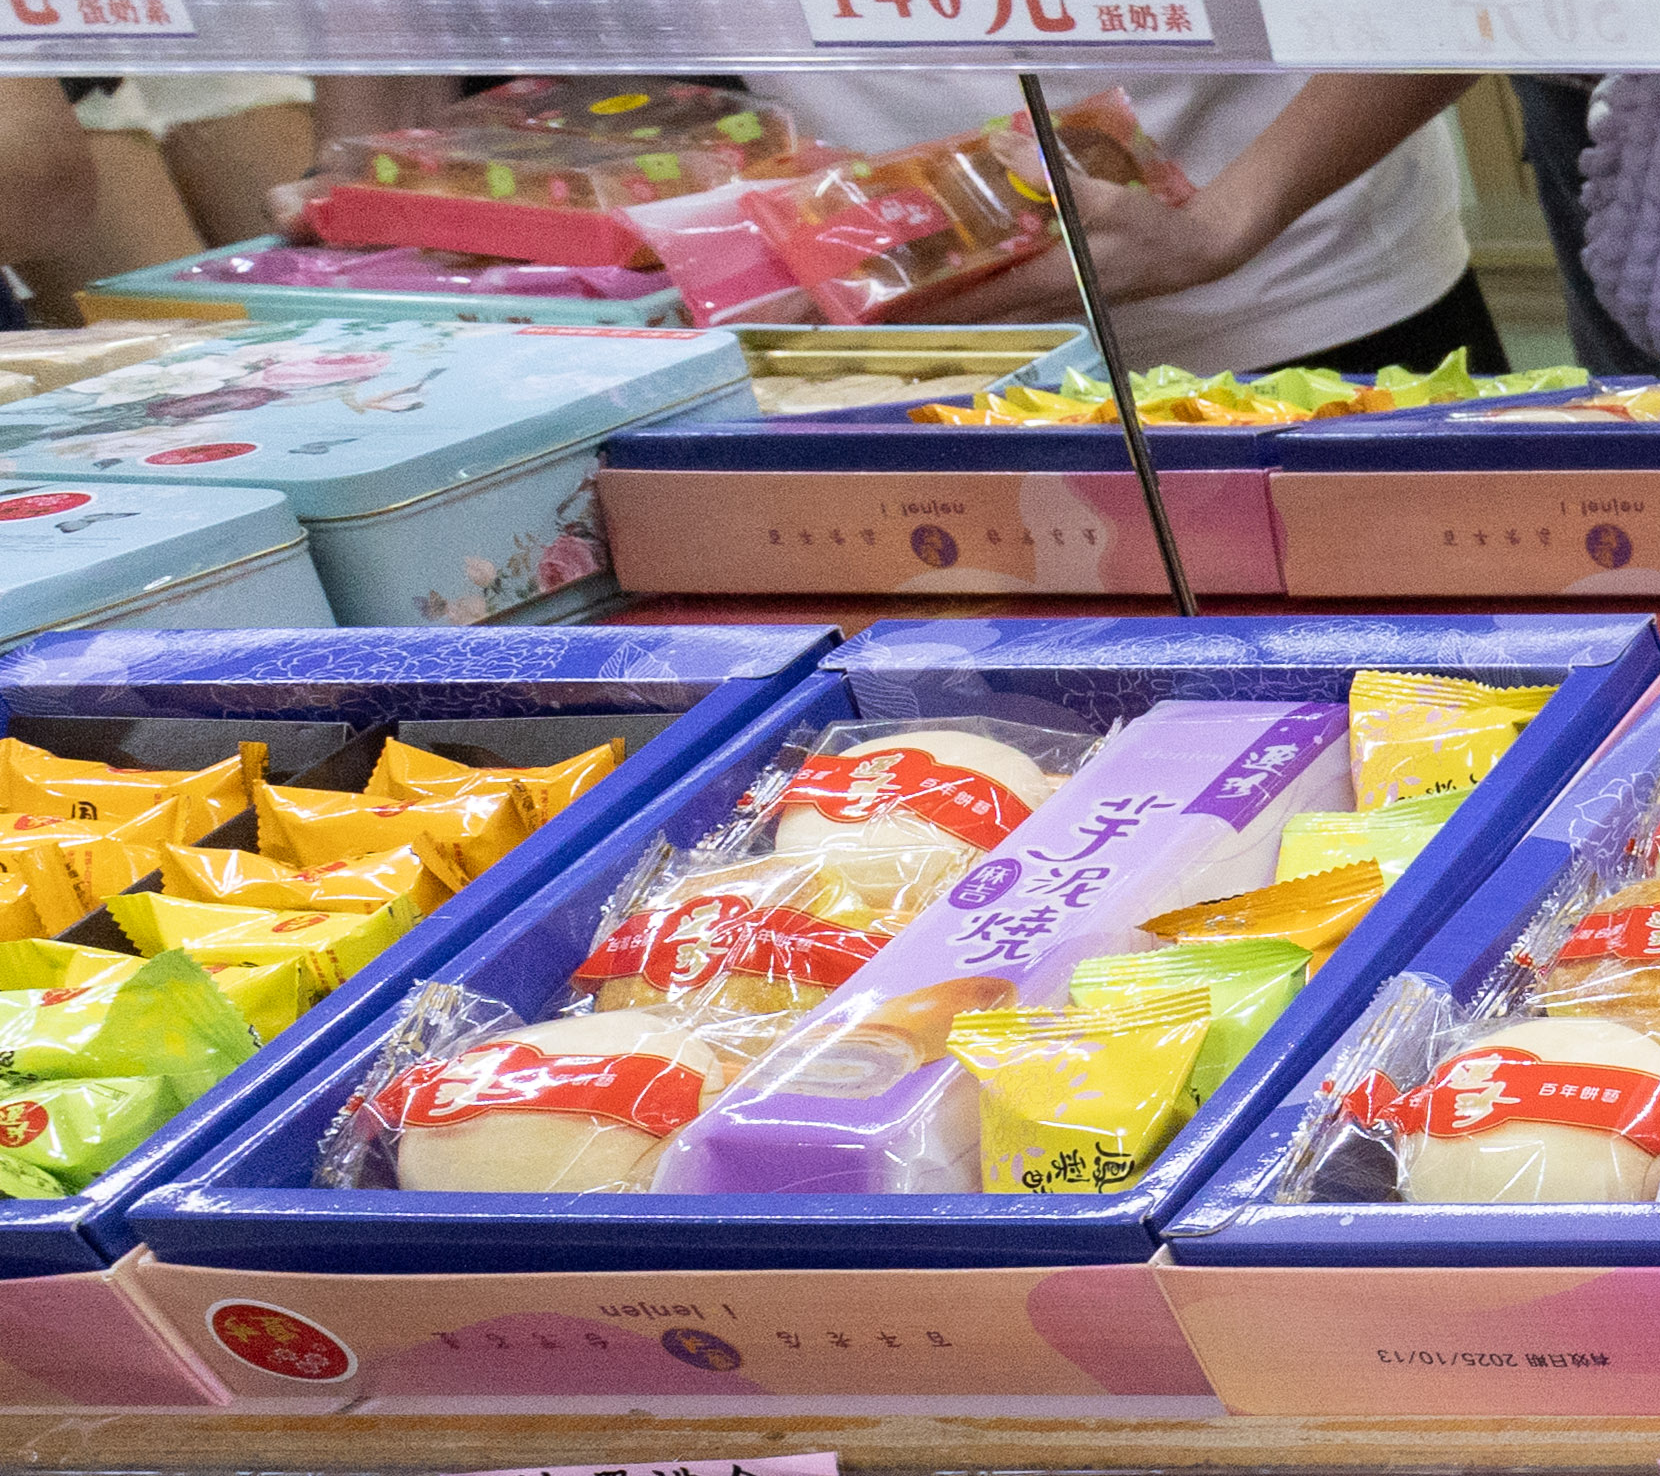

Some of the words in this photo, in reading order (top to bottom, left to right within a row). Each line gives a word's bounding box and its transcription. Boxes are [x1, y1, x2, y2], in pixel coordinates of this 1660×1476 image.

[1093, 4, 1193, 33] 蛋奶素
[968, 864, 1011, 905] 麻吉
[1537, 1082, 1622, 1105] 百年餅藝
[598, 1301, 705, 1321] lenjen
[1375, 1347, 1518, 1368] 2025/10/13
